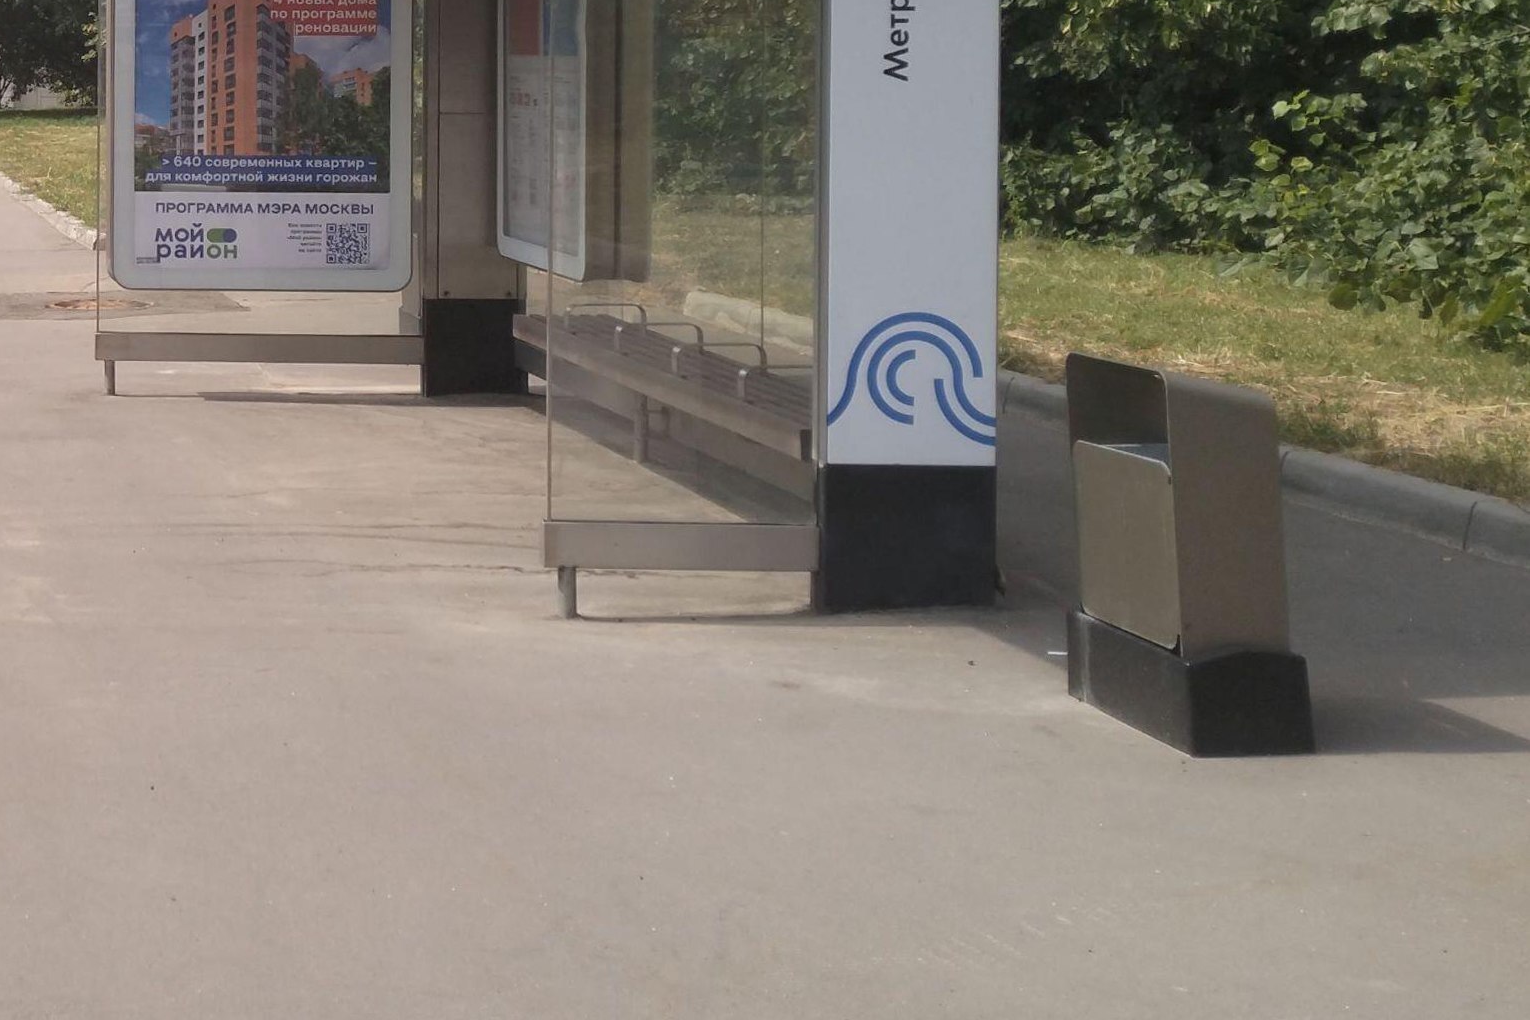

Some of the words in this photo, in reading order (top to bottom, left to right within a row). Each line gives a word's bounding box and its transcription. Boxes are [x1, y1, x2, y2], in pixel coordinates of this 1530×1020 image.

[270, 10, 288, 19] по
[292, 10, 377, 22] программе
[295, 24, 377, 35] реновации
[173, 156, 201, 167] 640
[205, 157, 302, 170] современных
[306, 158, 365, 170] квартир
[145, 173, 172, 183] для
[175, 171, 263, 184] комфортной
[268, 173, 312, 182] жизни
[315, 173, 377, 184] горожан
[155, 202, 253, 215] ПРОГРАММА
[257, 202, 301, 215] МЭРА
[305, 203, 374, 215] МОСКВЫ
[155, 223, 204, 243] мой
